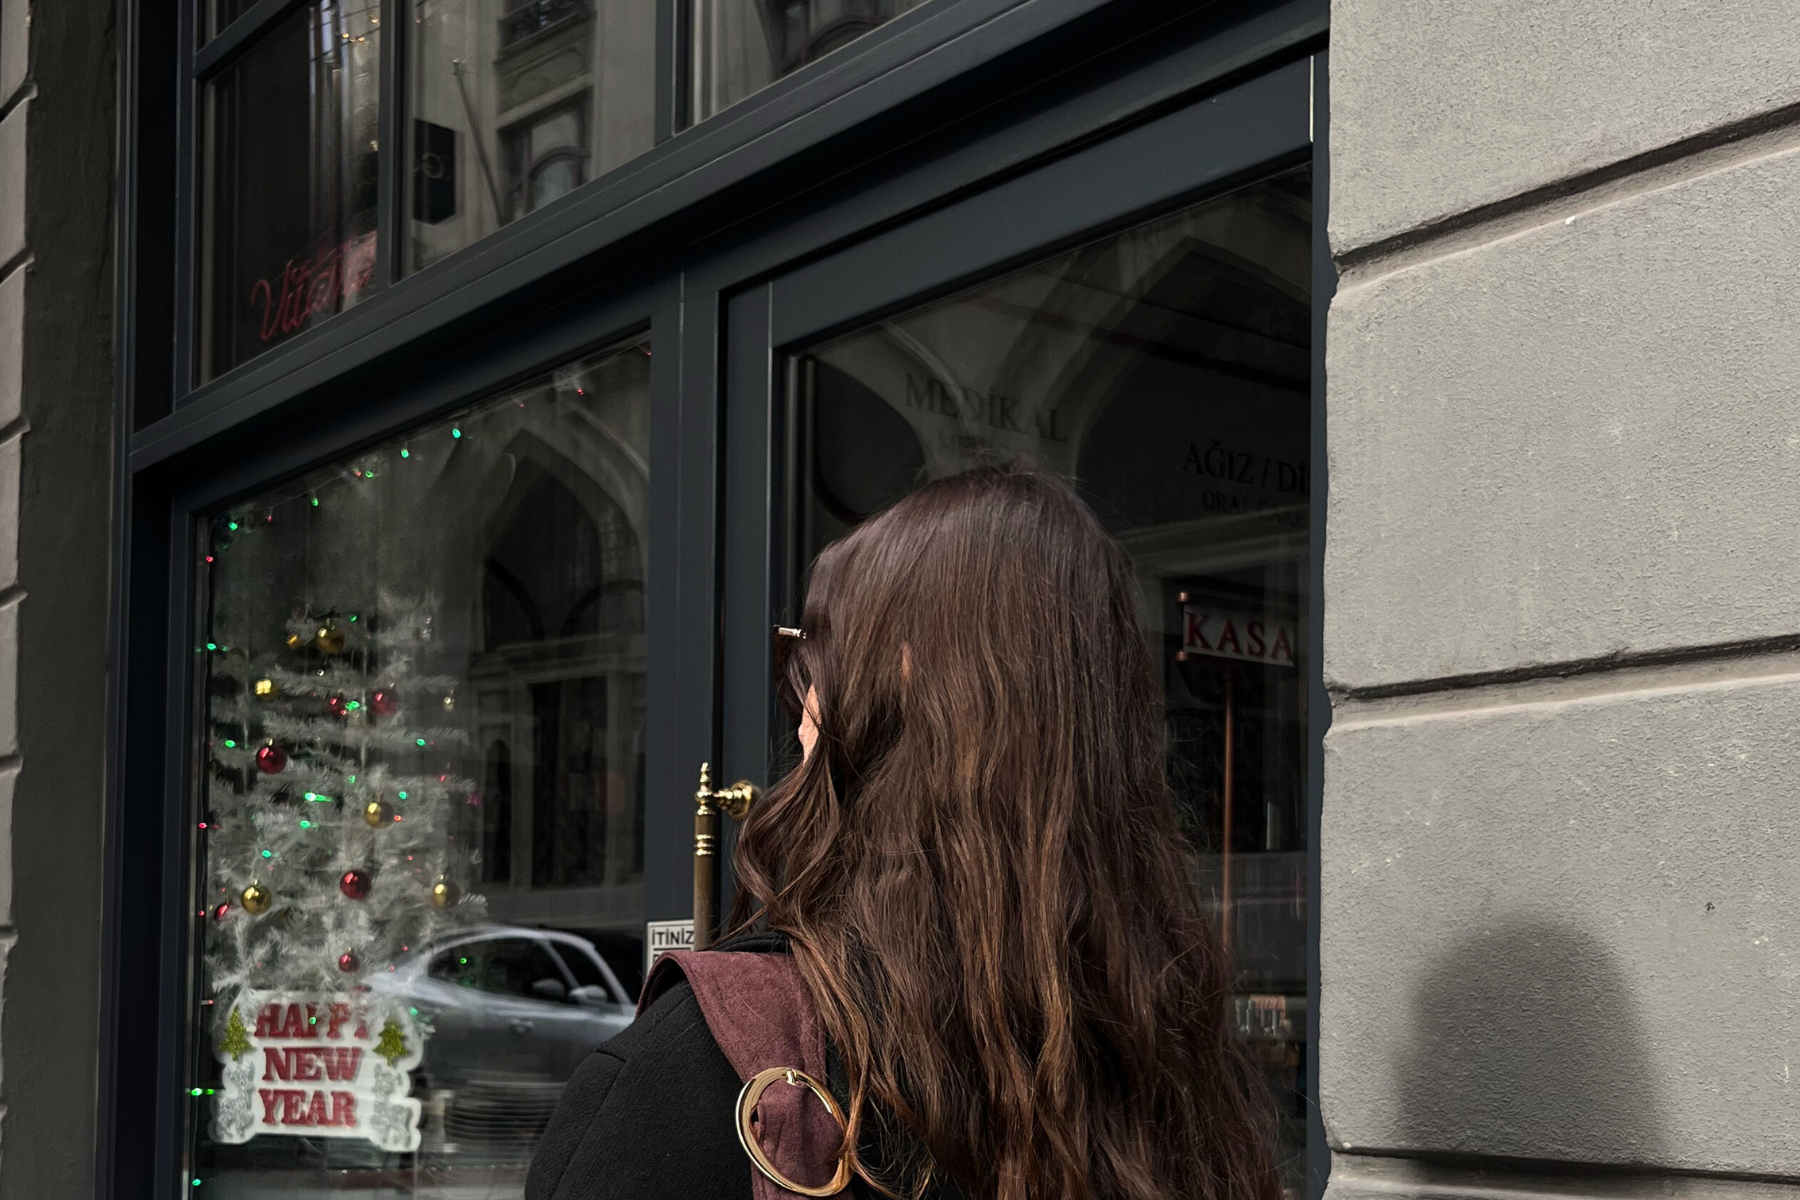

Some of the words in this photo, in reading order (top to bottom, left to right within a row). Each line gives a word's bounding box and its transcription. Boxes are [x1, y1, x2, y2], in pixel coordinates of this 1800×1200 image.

[1183, 438, 1255, 484] AĞIZ
[1277, 459, 1310, 496] Dİ
[1184, 611, 1293, 660] KASA
[652, 928, 694, 946] İTİNİZ
[261, 1046, 364, 1081] NEW
[258, 1089, 358, 1127] YEAR
